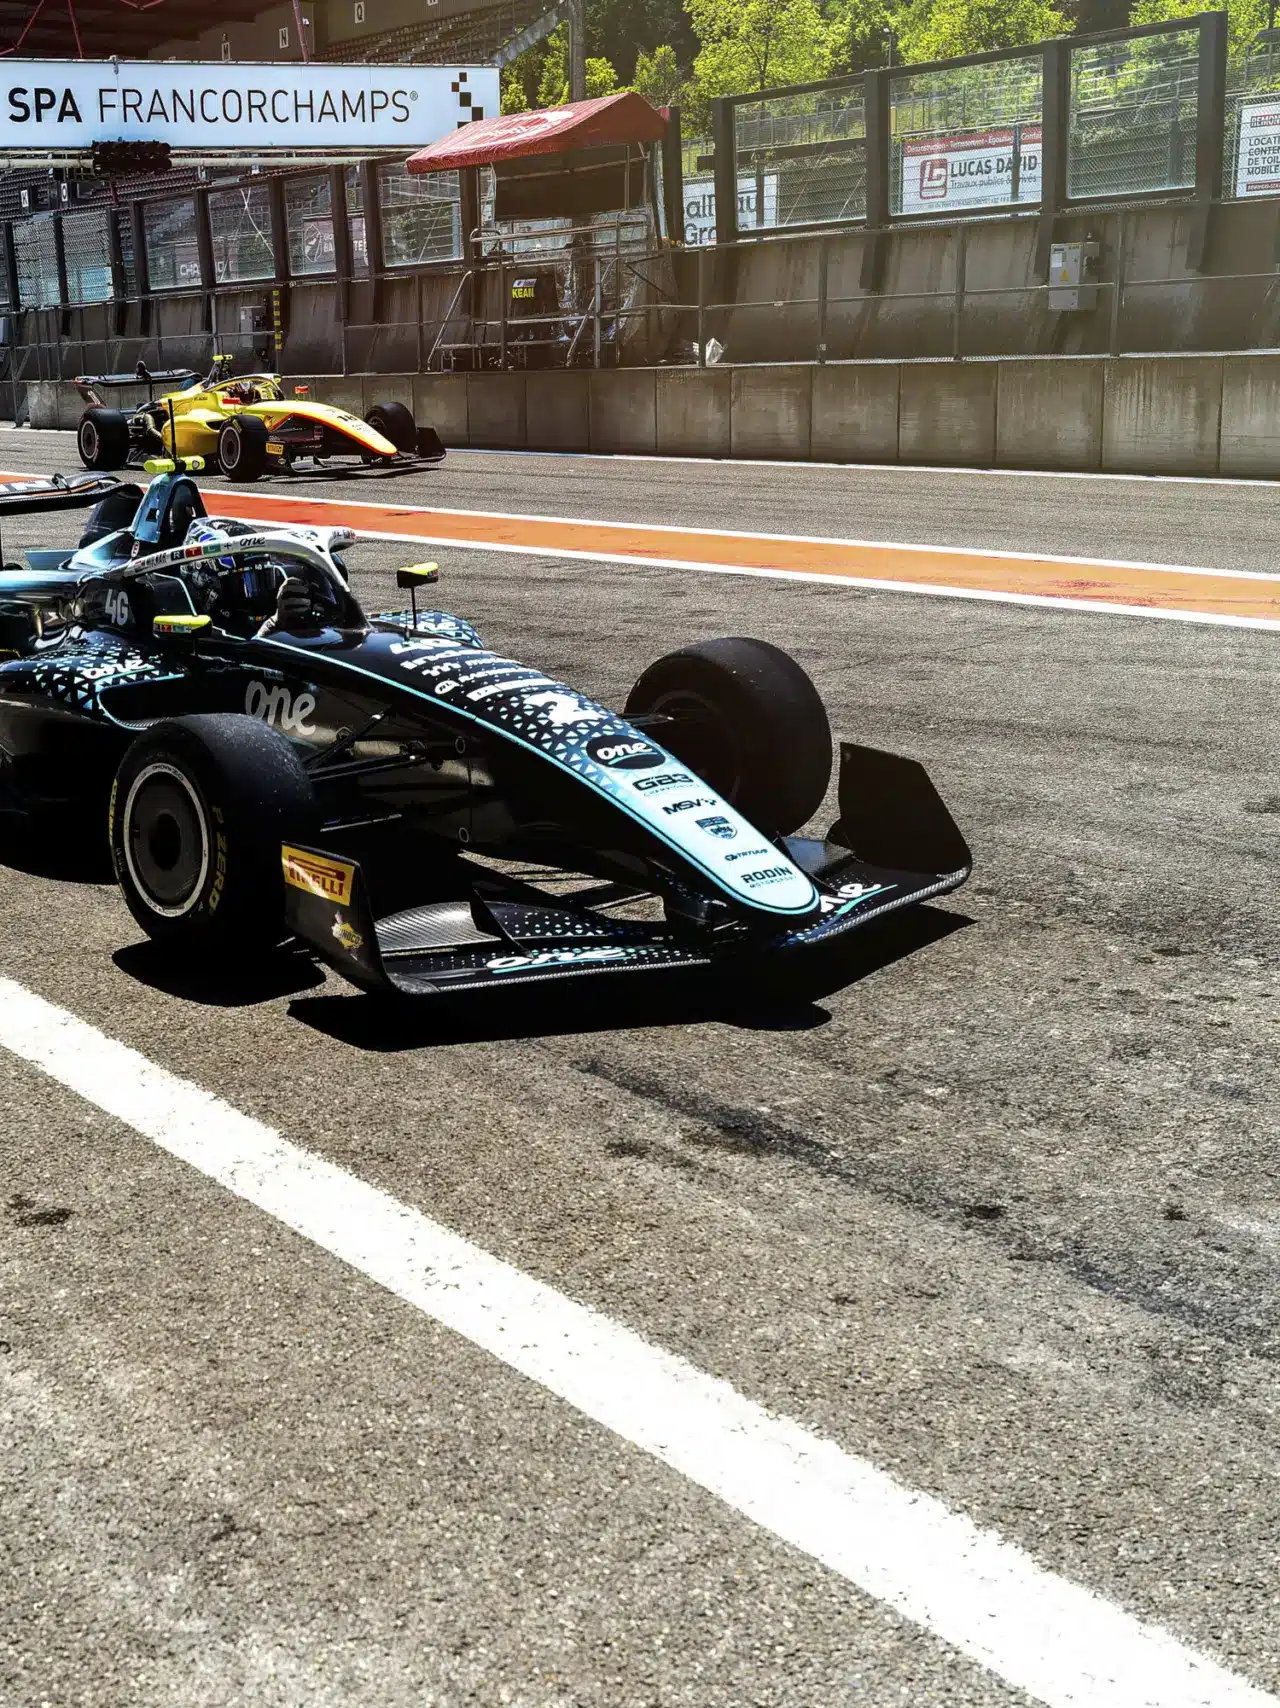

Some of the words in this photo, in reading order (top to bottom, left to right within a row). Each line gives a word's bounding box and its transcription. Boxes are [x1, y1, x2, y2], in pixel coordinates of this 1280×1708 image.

[8, 87, 83, 123] SPA
[951, 159, 991, 177] LUCAS
[996, 155, 1038, 174] DAID
[1247, 157, 1260, 166] DE
[239, 535, 266, 549] one
[245, 680, 317, 736] one
[596, 742, 653, 760] one
[632, 773, 694, 791] GB3
[662, 798, 701, 815] MSV
[741, 867, 793, 884] RODIN
[486, 949, 627, 969] one
